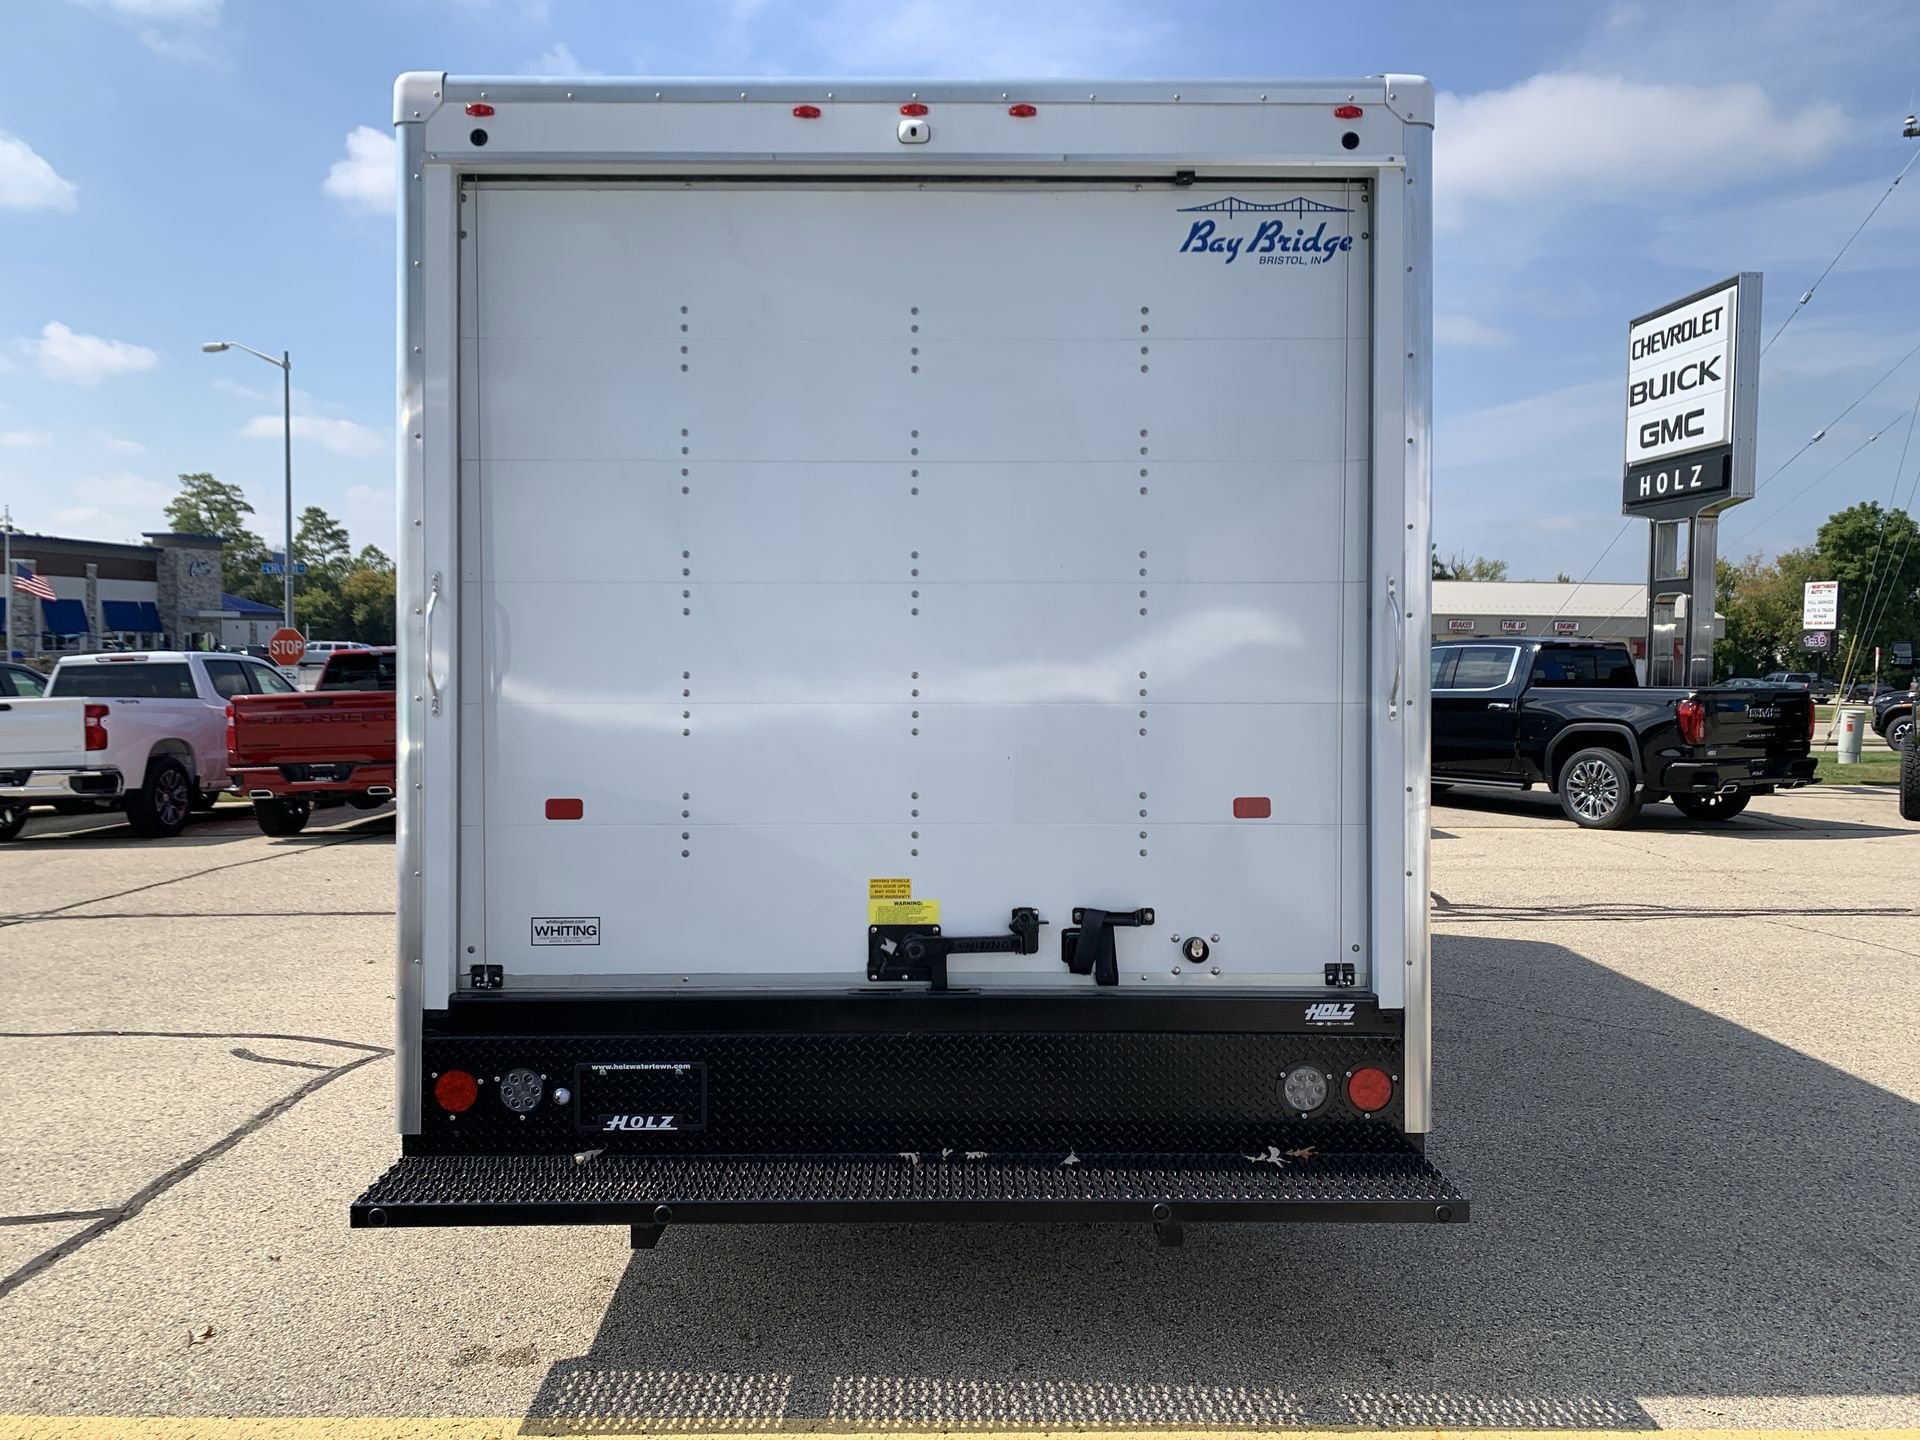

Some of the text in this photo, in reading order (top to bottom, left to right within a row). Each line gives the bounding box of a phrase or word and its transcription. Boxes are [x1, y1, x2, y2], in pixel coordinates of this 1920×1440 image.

[1179, 220, 1353, 264] Bay Bridge
[1259, 256, 1322, 266] BRISTOL, IN
[1632, 306, 1723, 360] CHEVROLET
[1629, 355, 1721, 407] BUICK
[1640, 408, 1704, 449] GMC
[1640, 465, 1702, 496] HOLZ
[1450, 621, 1473, 629] BRAKES
[1557, 622, 1577, 630] ENGINE
[271, 640, 302, 655] STOP
[1803, 635, 1827, 647] 1:39
[534, 925, 597, 936] WHITING
[1305, 1003, 1355, 1020] HOLZ
[603, 1115, 678, 1131] HOLZ
